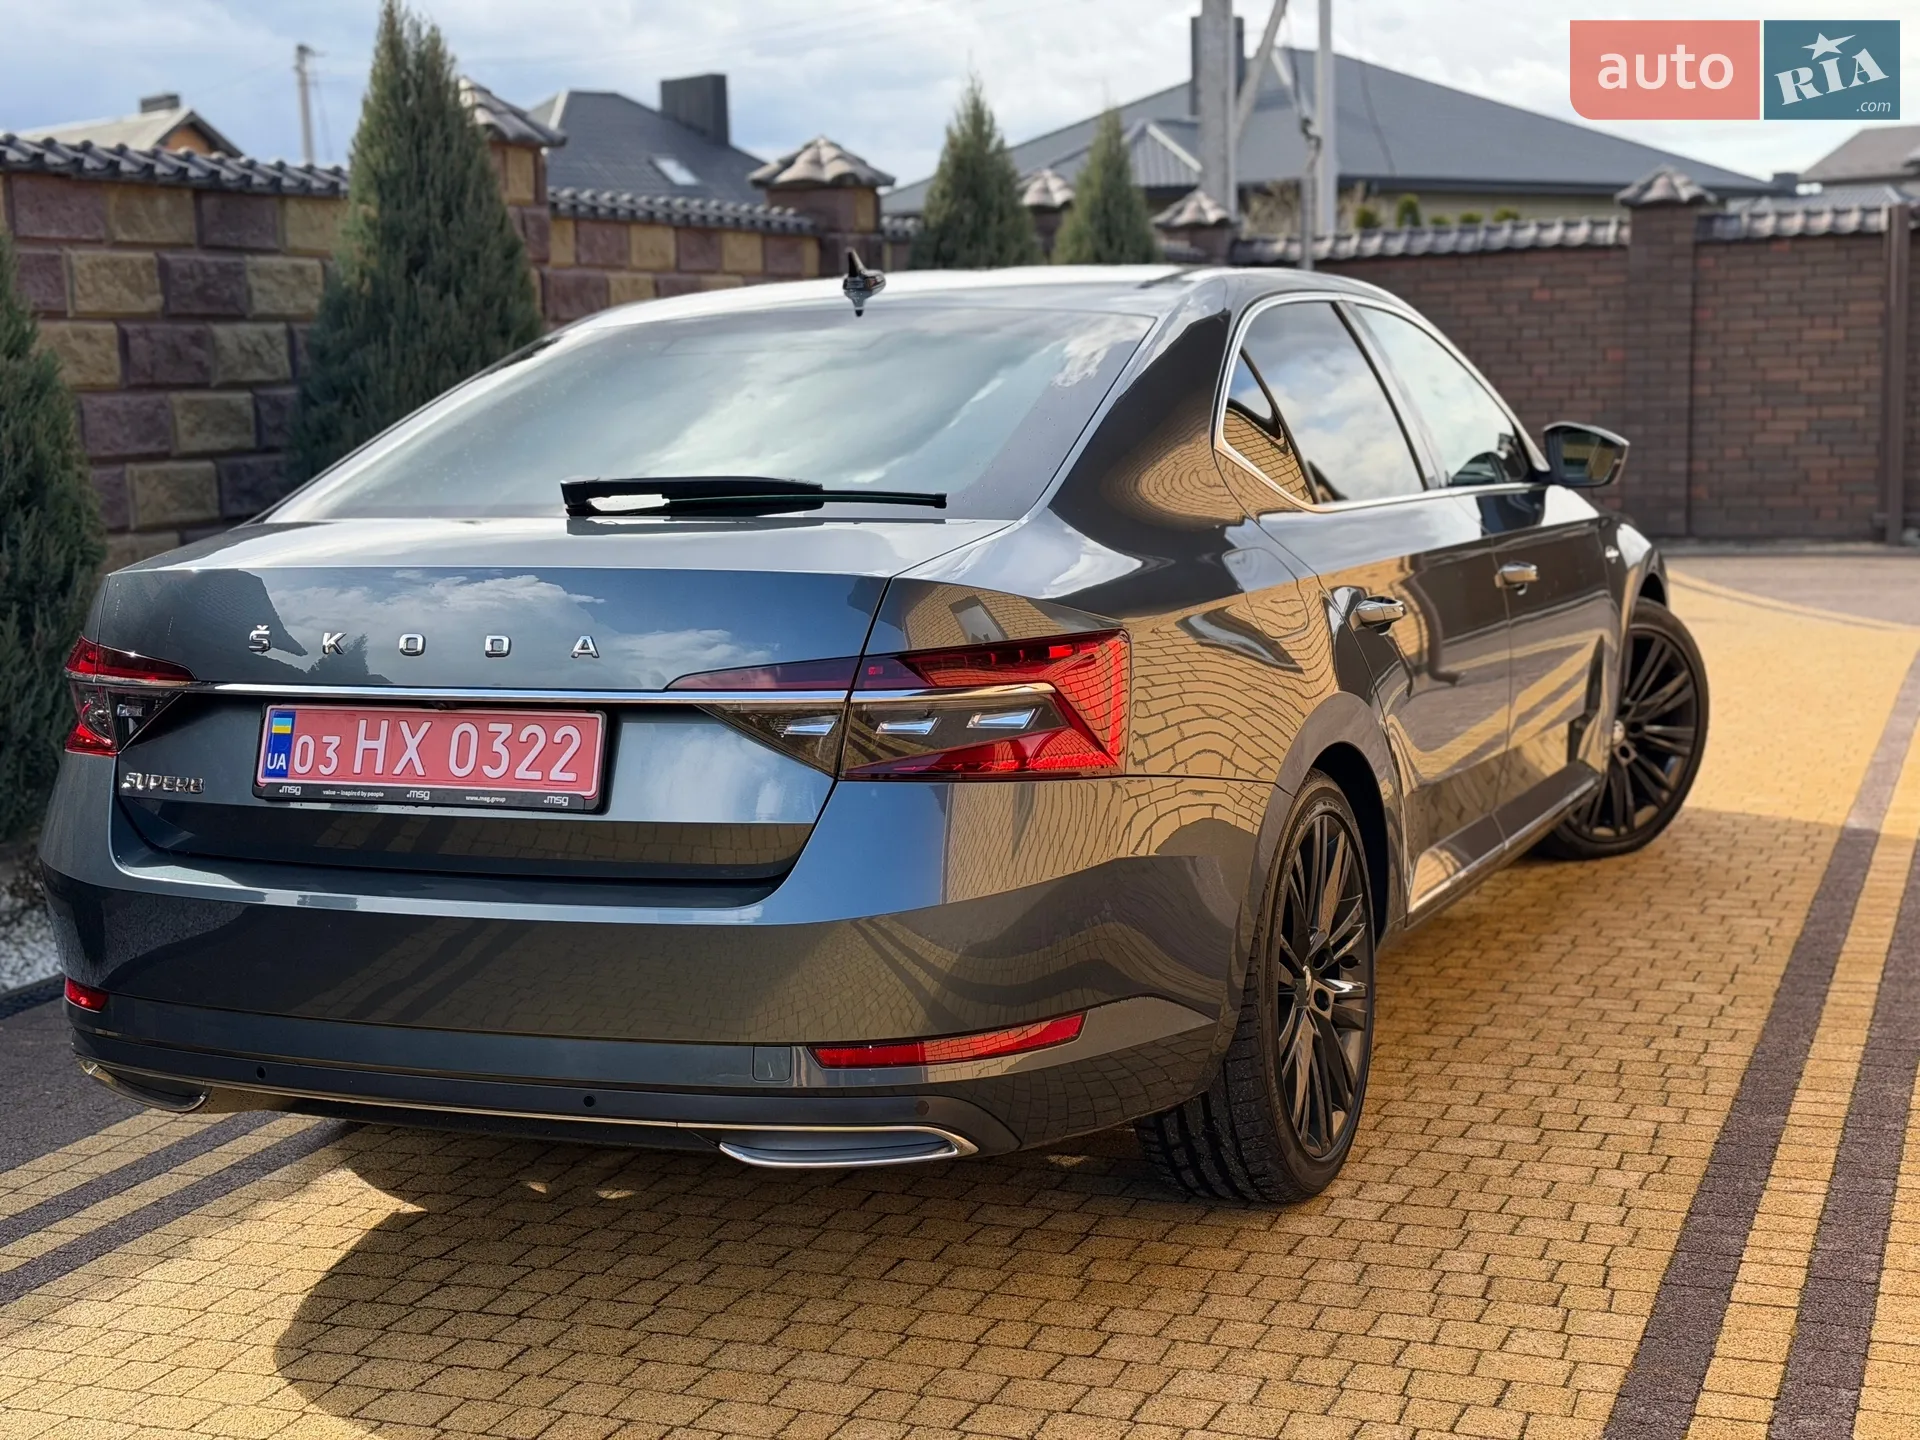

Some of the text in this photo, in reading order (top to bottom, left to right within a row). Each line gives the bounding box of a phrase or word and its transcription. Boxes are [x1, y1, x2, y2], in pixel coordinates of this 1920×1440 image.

[248, 624, 601, 659] ŠKODA
[267, 752, 287, 770] UA
[293, 718, 582, 783] 03 HX 0322
[121, 772, 205, 793] SUPERB
